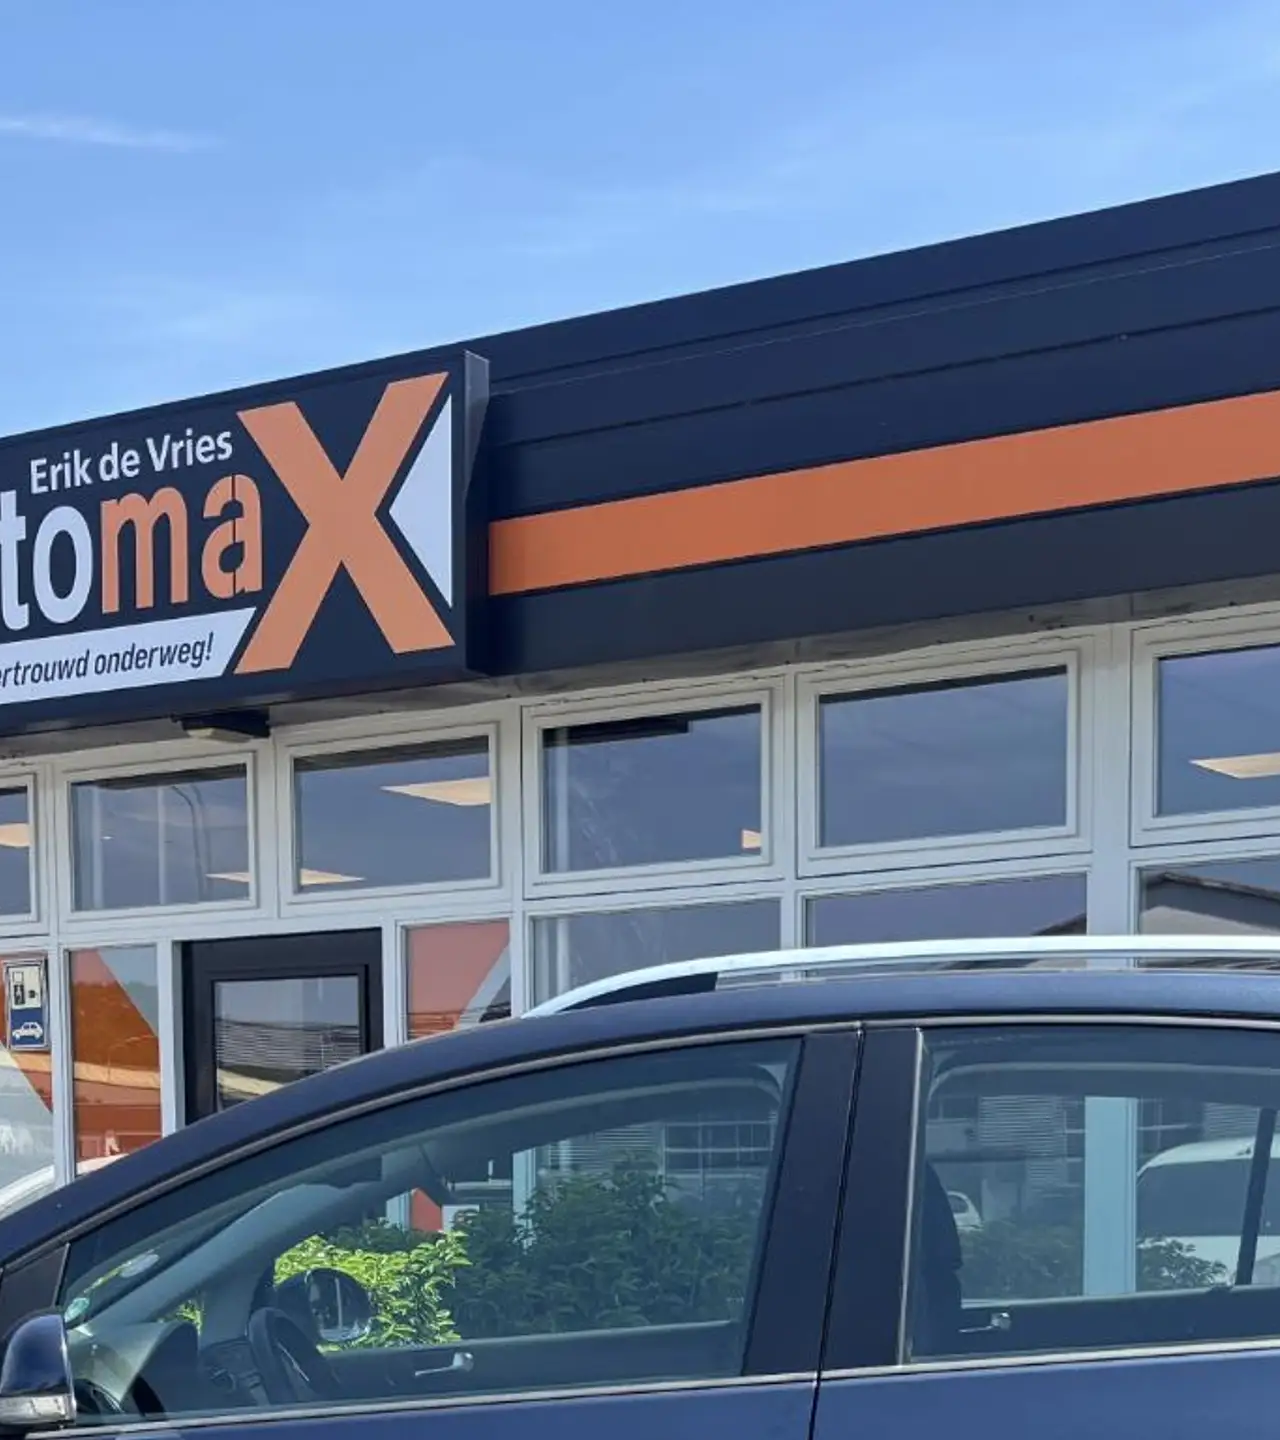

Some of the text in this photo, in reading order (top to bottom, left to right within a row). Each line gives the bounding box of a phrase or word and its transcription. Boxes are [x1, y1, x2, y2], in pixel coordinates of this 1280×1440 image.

[31, 428, 233, 494] Erik de Vries
[94, 631, 214, 675] onderweg!
